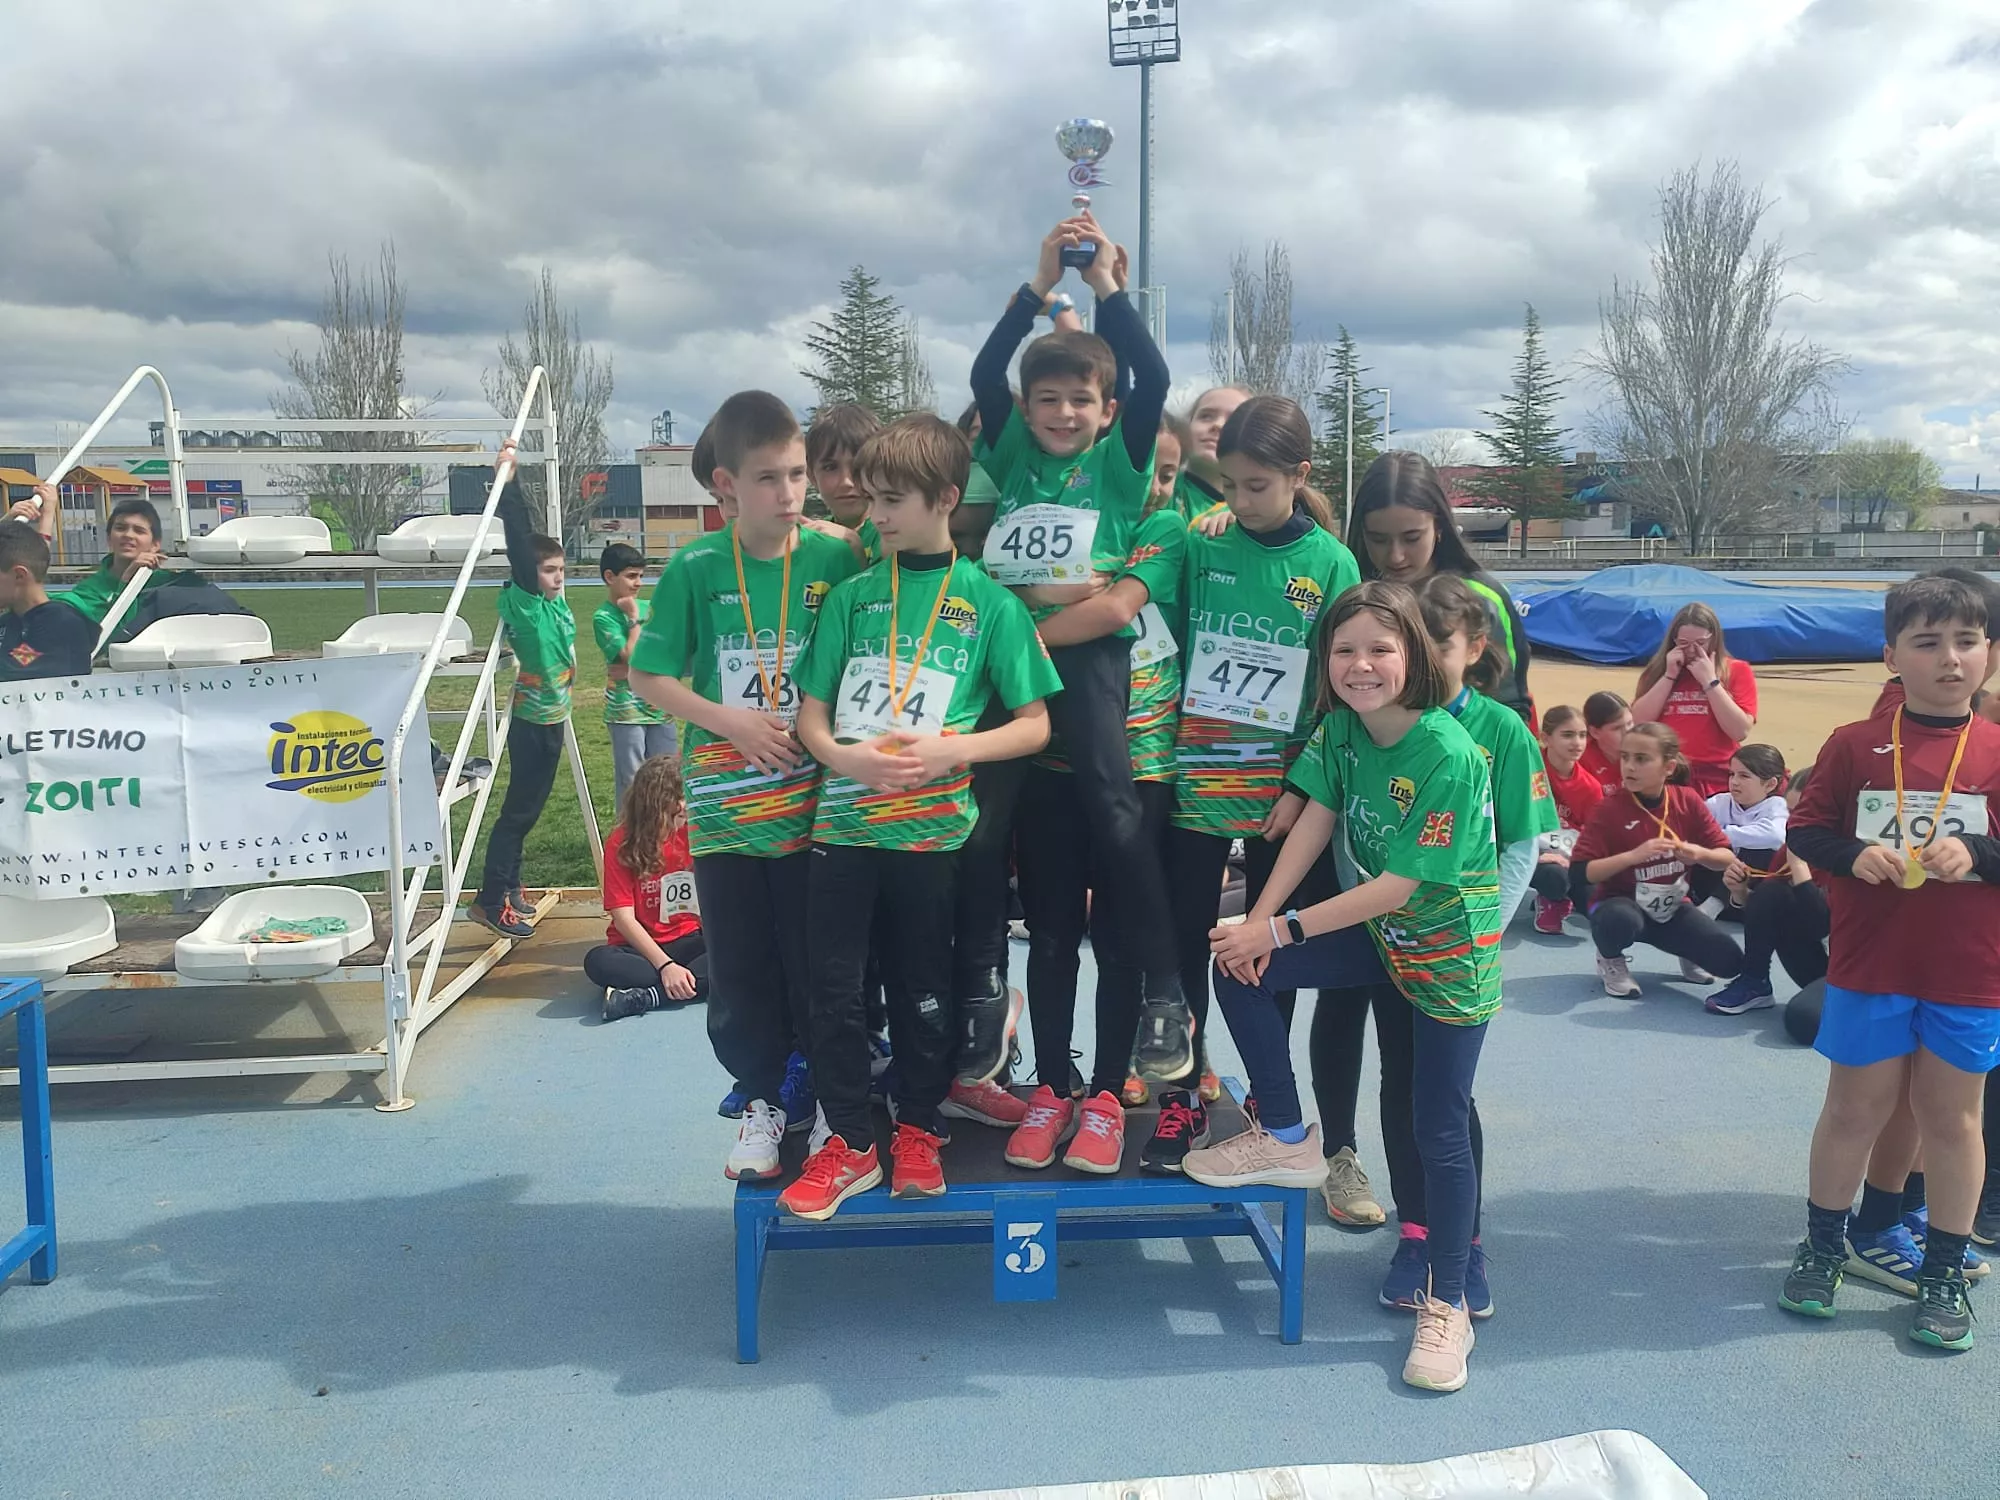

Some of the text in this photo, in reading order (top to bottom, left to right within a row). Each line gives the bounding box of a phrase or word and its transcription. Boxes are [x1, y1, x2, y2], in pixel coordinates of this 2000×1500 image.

[1000, 525, 1075, 561] 485
[82, 678, 232, 700] ATLETISMO
[248, 673, 318, 688] ZOITI
[742, 672, 804, 706] 48
[1207, 659, 1287, 702] 477
[850, 679, 926, 727] 474
[0, 728, 146, 759] LETISMO
[269, 721, 385, 775] intec
[24, 777, 141, 815] ZOITI
[256, 841, 433, 868] ELECTRICIAD
[667, 883, 692, 902] 08
[1005, 1222, 1046, 1274] 3
